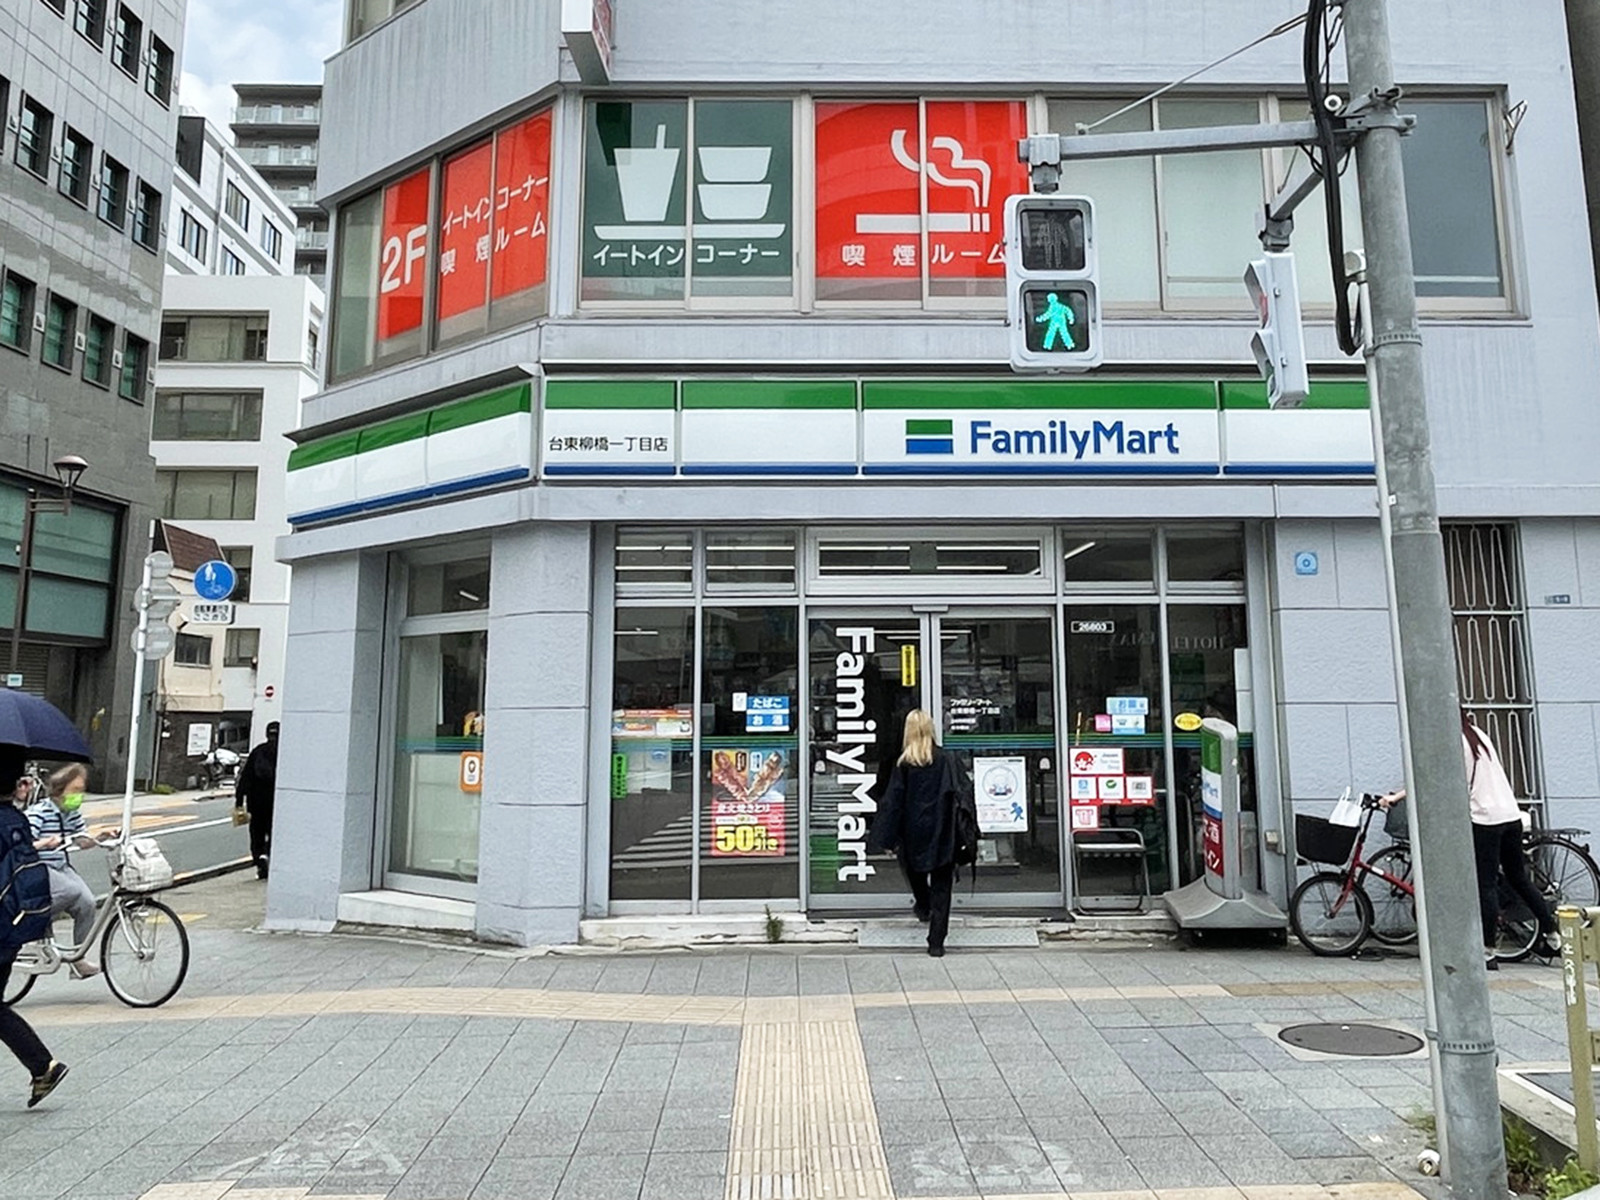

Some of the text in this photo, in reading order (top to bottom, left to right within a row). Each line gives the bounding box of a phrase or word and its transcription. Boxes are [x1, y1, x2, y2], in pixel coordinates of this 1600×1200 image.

[380, 224, 427, 294] 2F
[548, 436, 668, 452] 台東柳橋一丁目店
[970, 419, 1180, 460] FamilyMart
[752, 697, 783, 708] たばこ
[825, 626, 878, 882] FamilyMart
